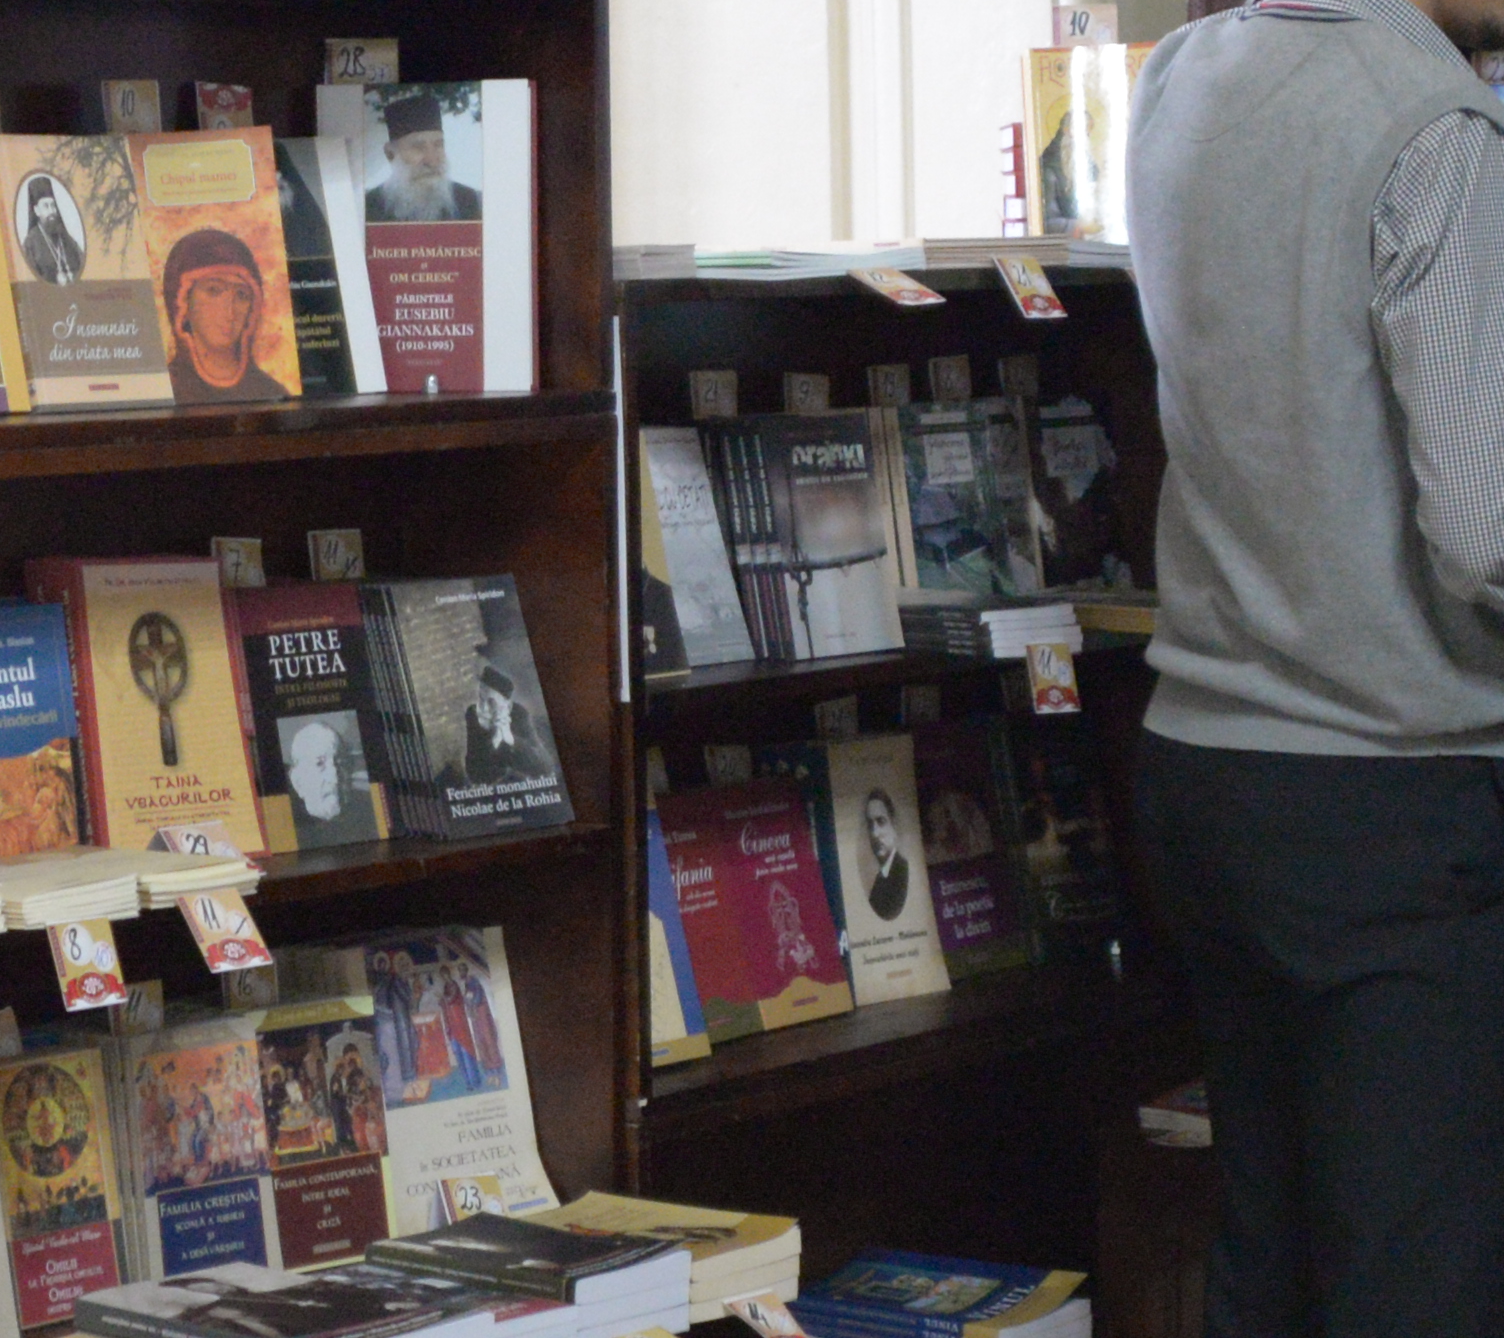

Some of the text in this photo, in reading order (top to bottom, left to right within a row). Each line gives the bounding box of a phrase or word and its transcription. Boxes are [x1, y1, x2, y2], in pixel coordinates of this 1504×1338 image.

[389, 272, 411, 284] OM
[395, 292, 454, 304] PĂRINTELE
[394, 307, 455, 321] EUSEBIU
[377, 323, 474, 338] GIANNAKAKIS
[49, 343, 142, 363] din mea
[267, 628, 342, 657] PETRE
[149, 773, 204, 791] TAINA
[446, 772, 559, 803] Fericirile monahului
[450, 789, 562, 819] Nicolae de la Rohia
[67, 927, 83, 962] 8
[457, 1122, 513, 1145] FAMILIA
[431, 1144, 517, 1171] SOCIETATEA
[273, 1176, 307, 1192] FAMILIA
[458, 1185, 483, 1211] 23
[159, 1201, 202, 1218] FAMILIA
